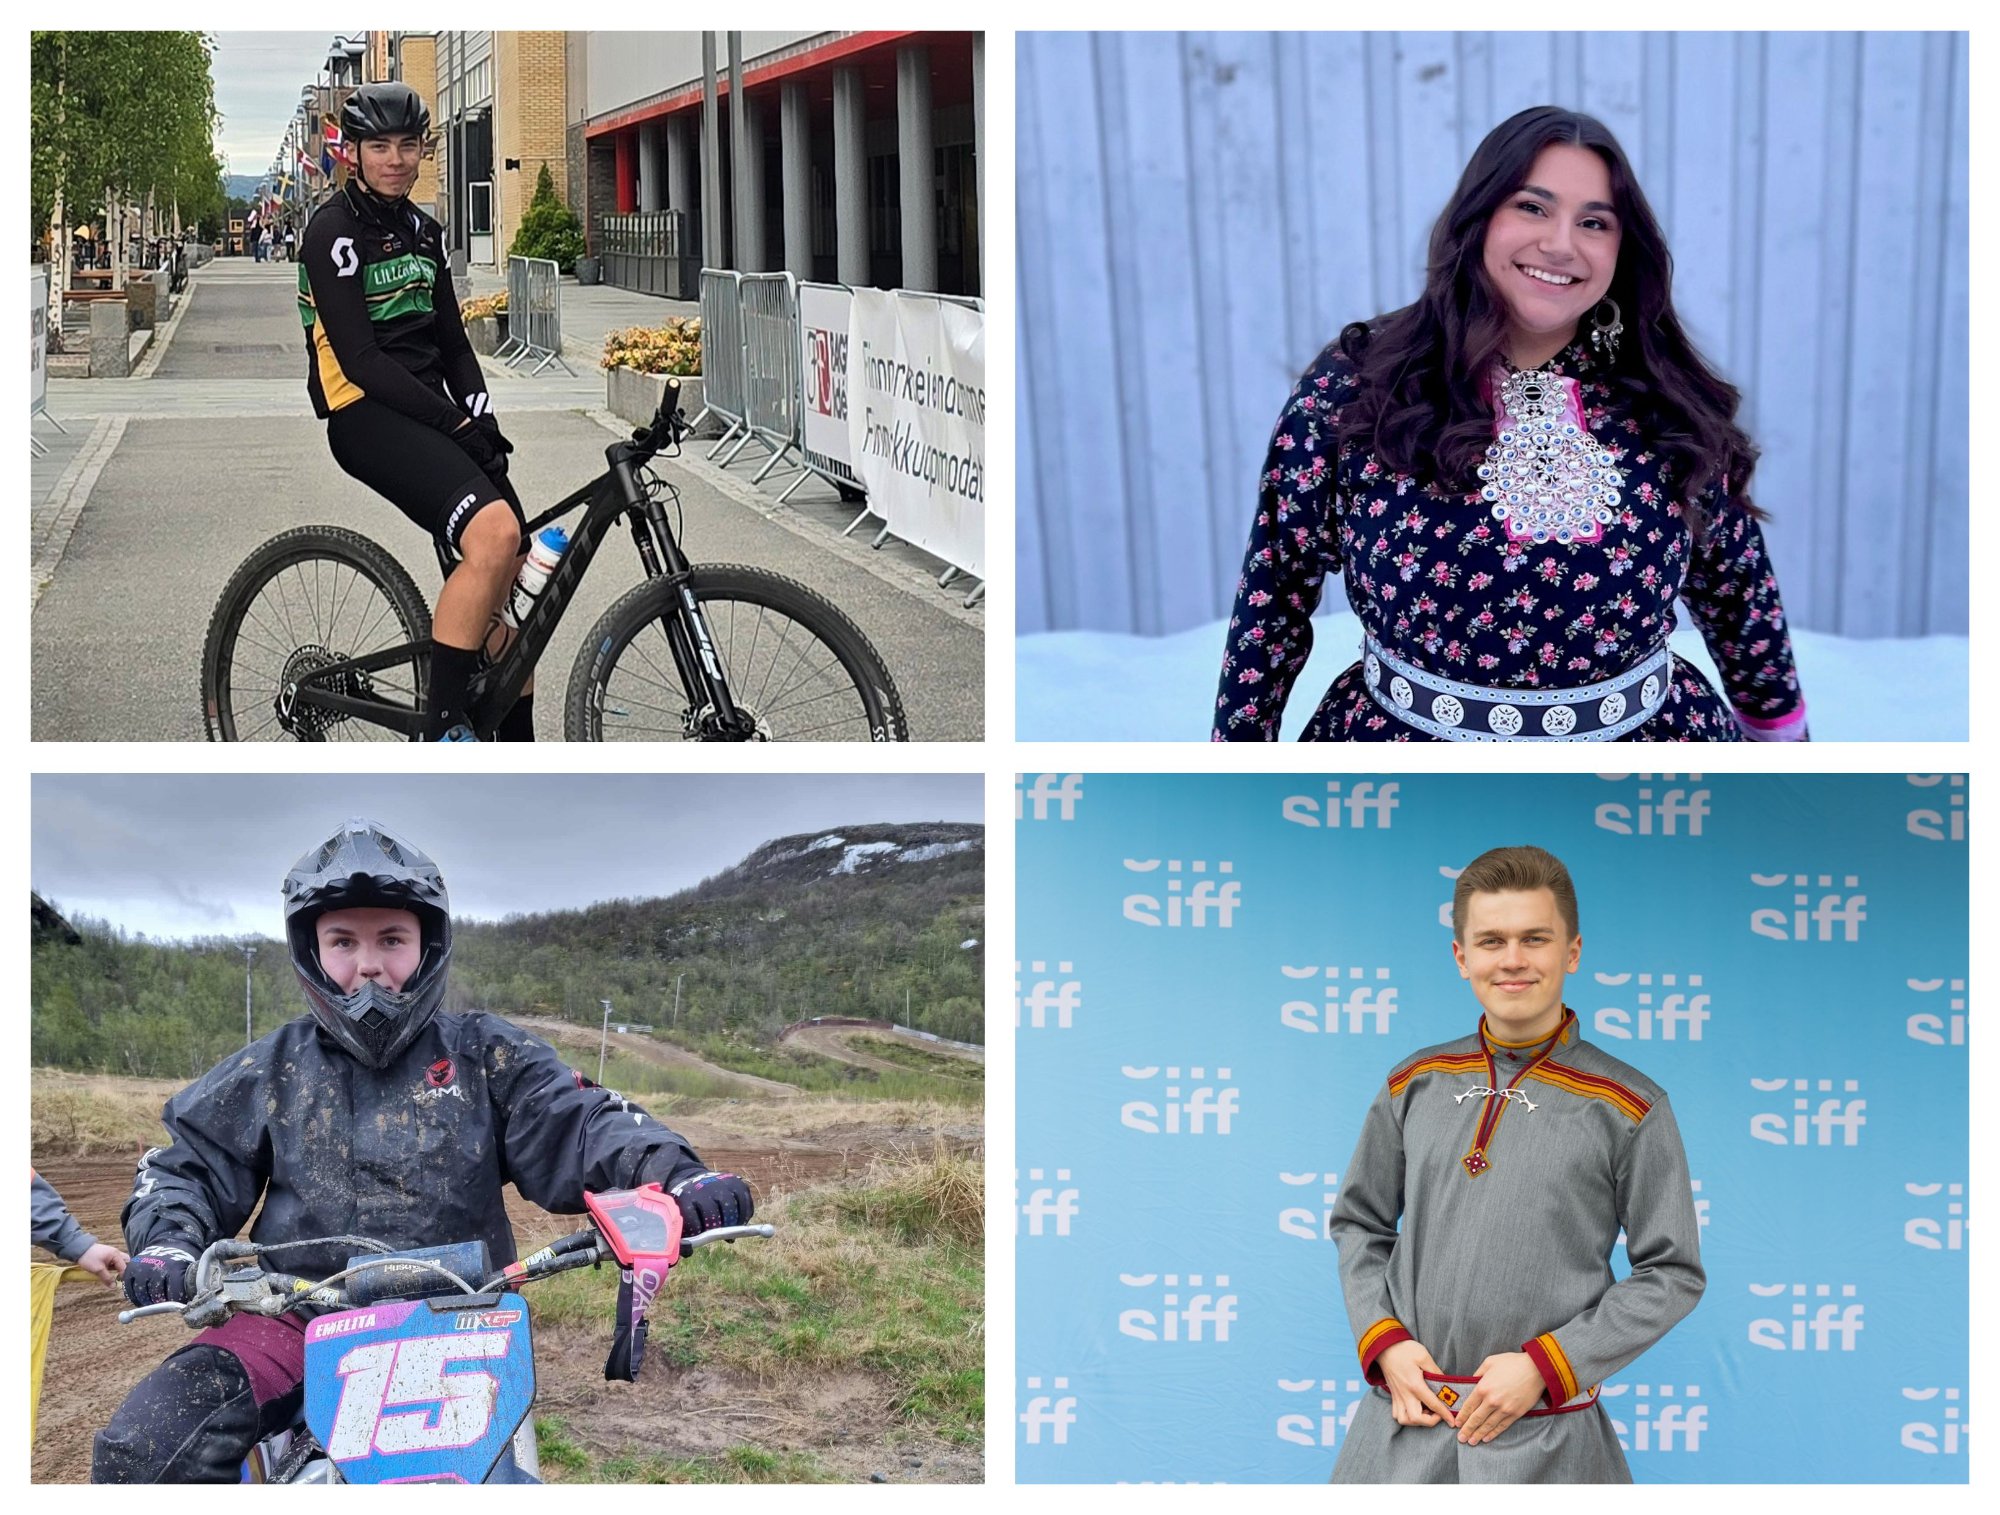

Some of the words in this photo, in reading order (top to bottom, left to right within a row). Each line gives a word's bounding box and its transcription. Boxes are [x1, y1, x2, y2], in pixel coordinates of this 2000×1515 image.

[1016, 775, 1083, 820] iff
[1282, 781, 1399, 828] siff
[1595, 789, 1711, 835] siff
[1906, 793, 1969, 841] si
[1122, 880, 1241, 928] siff
[1750, 894, 1867, 942] siff
[1280, 985, 1398, 1035] siff
[1594, 992, 1711, 1041] siff
[1906, 998, 1969, 1046] si
[1120, 1086, 1240, 1136] siff
[1750, 1098, 1867, 1147] siff
[314, 1313, 377, 1338] EMELITA
[455, 1310, 522, 1332] MXGP
[1118, 1294, 1239, 1342] siff
[1748, 1304, 1865, 1352] siff
[327, 1331, 512, 1463] 15
[1018, 1396, 1078, 1445] ff
